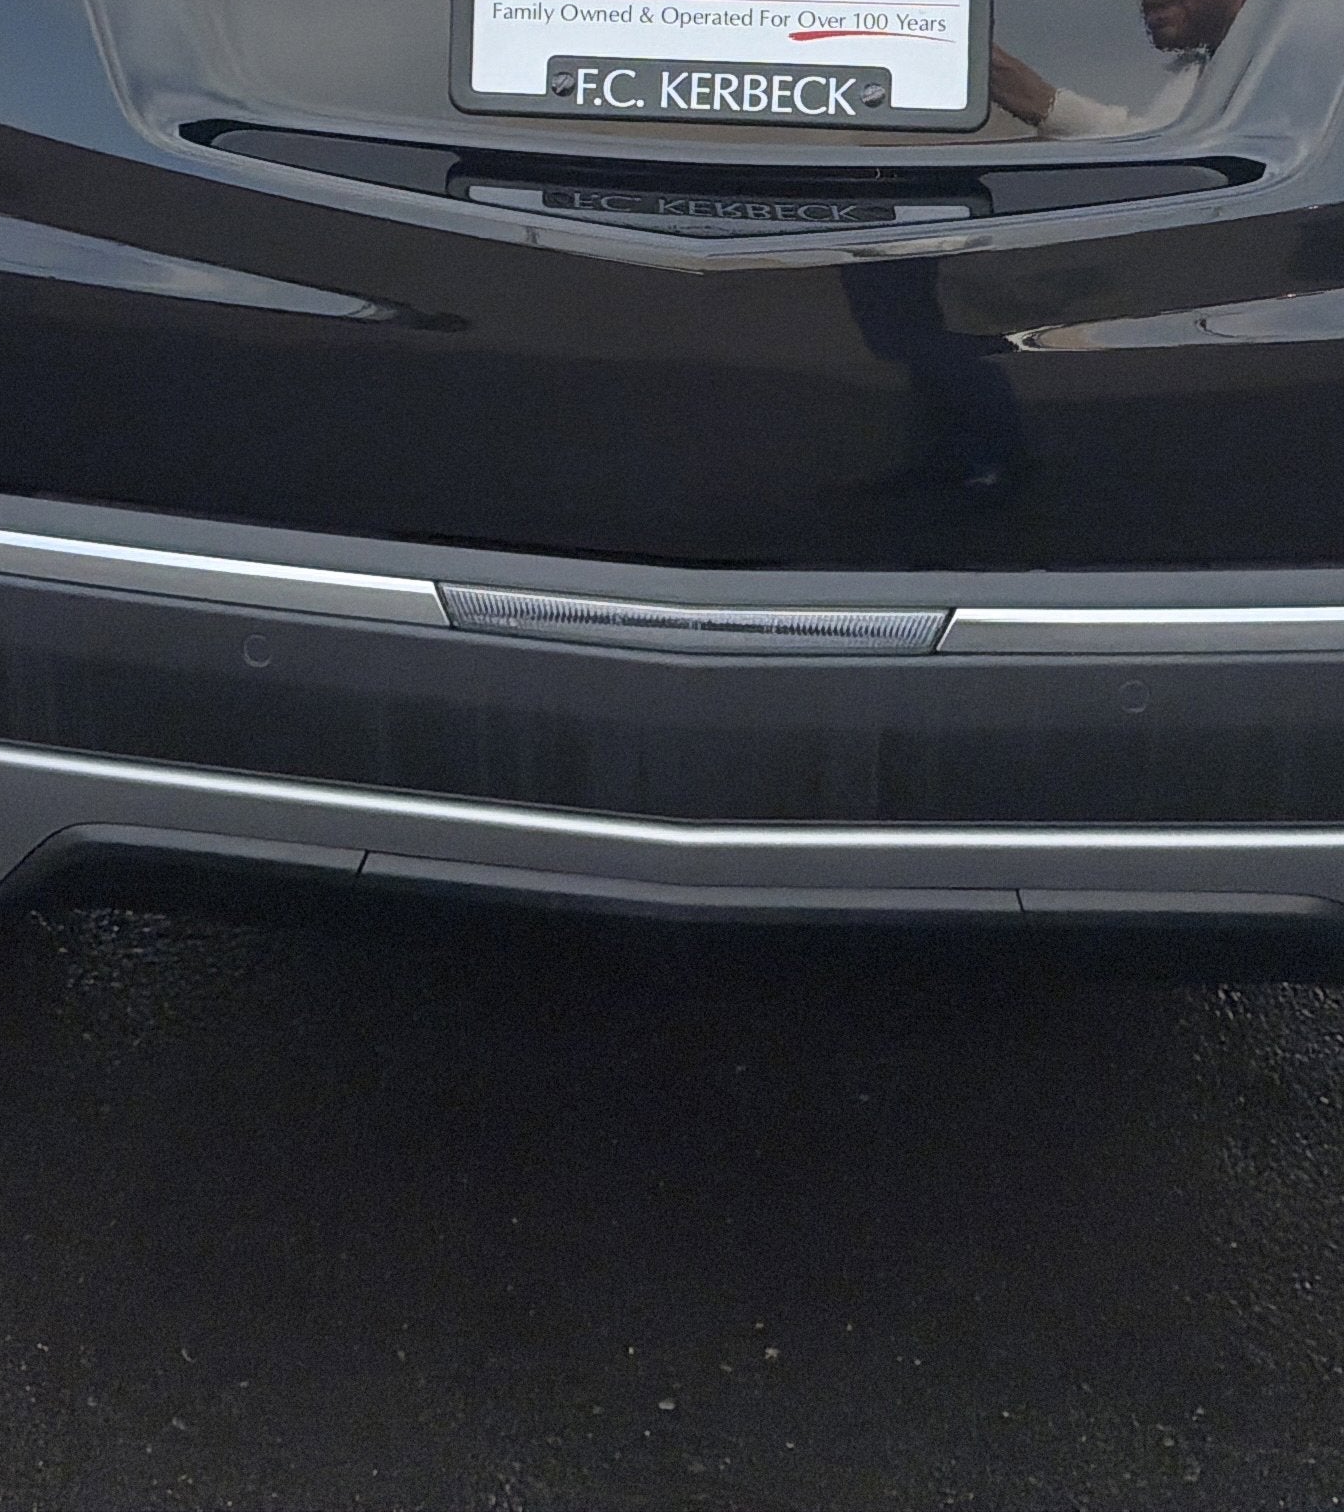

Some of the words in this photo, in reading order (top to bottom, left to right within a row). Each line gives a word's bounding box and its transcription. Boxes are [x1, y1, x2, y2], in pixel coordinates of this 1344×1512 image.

[492, 1, 554, 25] Family
[560, 3, 632, 24] Owned
[639, 6, 655, 24] &
[661, 5, 753, 29] Operated
[760, 9, 791, 28] For
[797, 10, 846, 30] Over
[854, 12, 889, 31] 100
[896, 13, 947, 32] Years
[576, 68, 645, 108] F.C.
[660, 71, 857, 116] KERBECK
